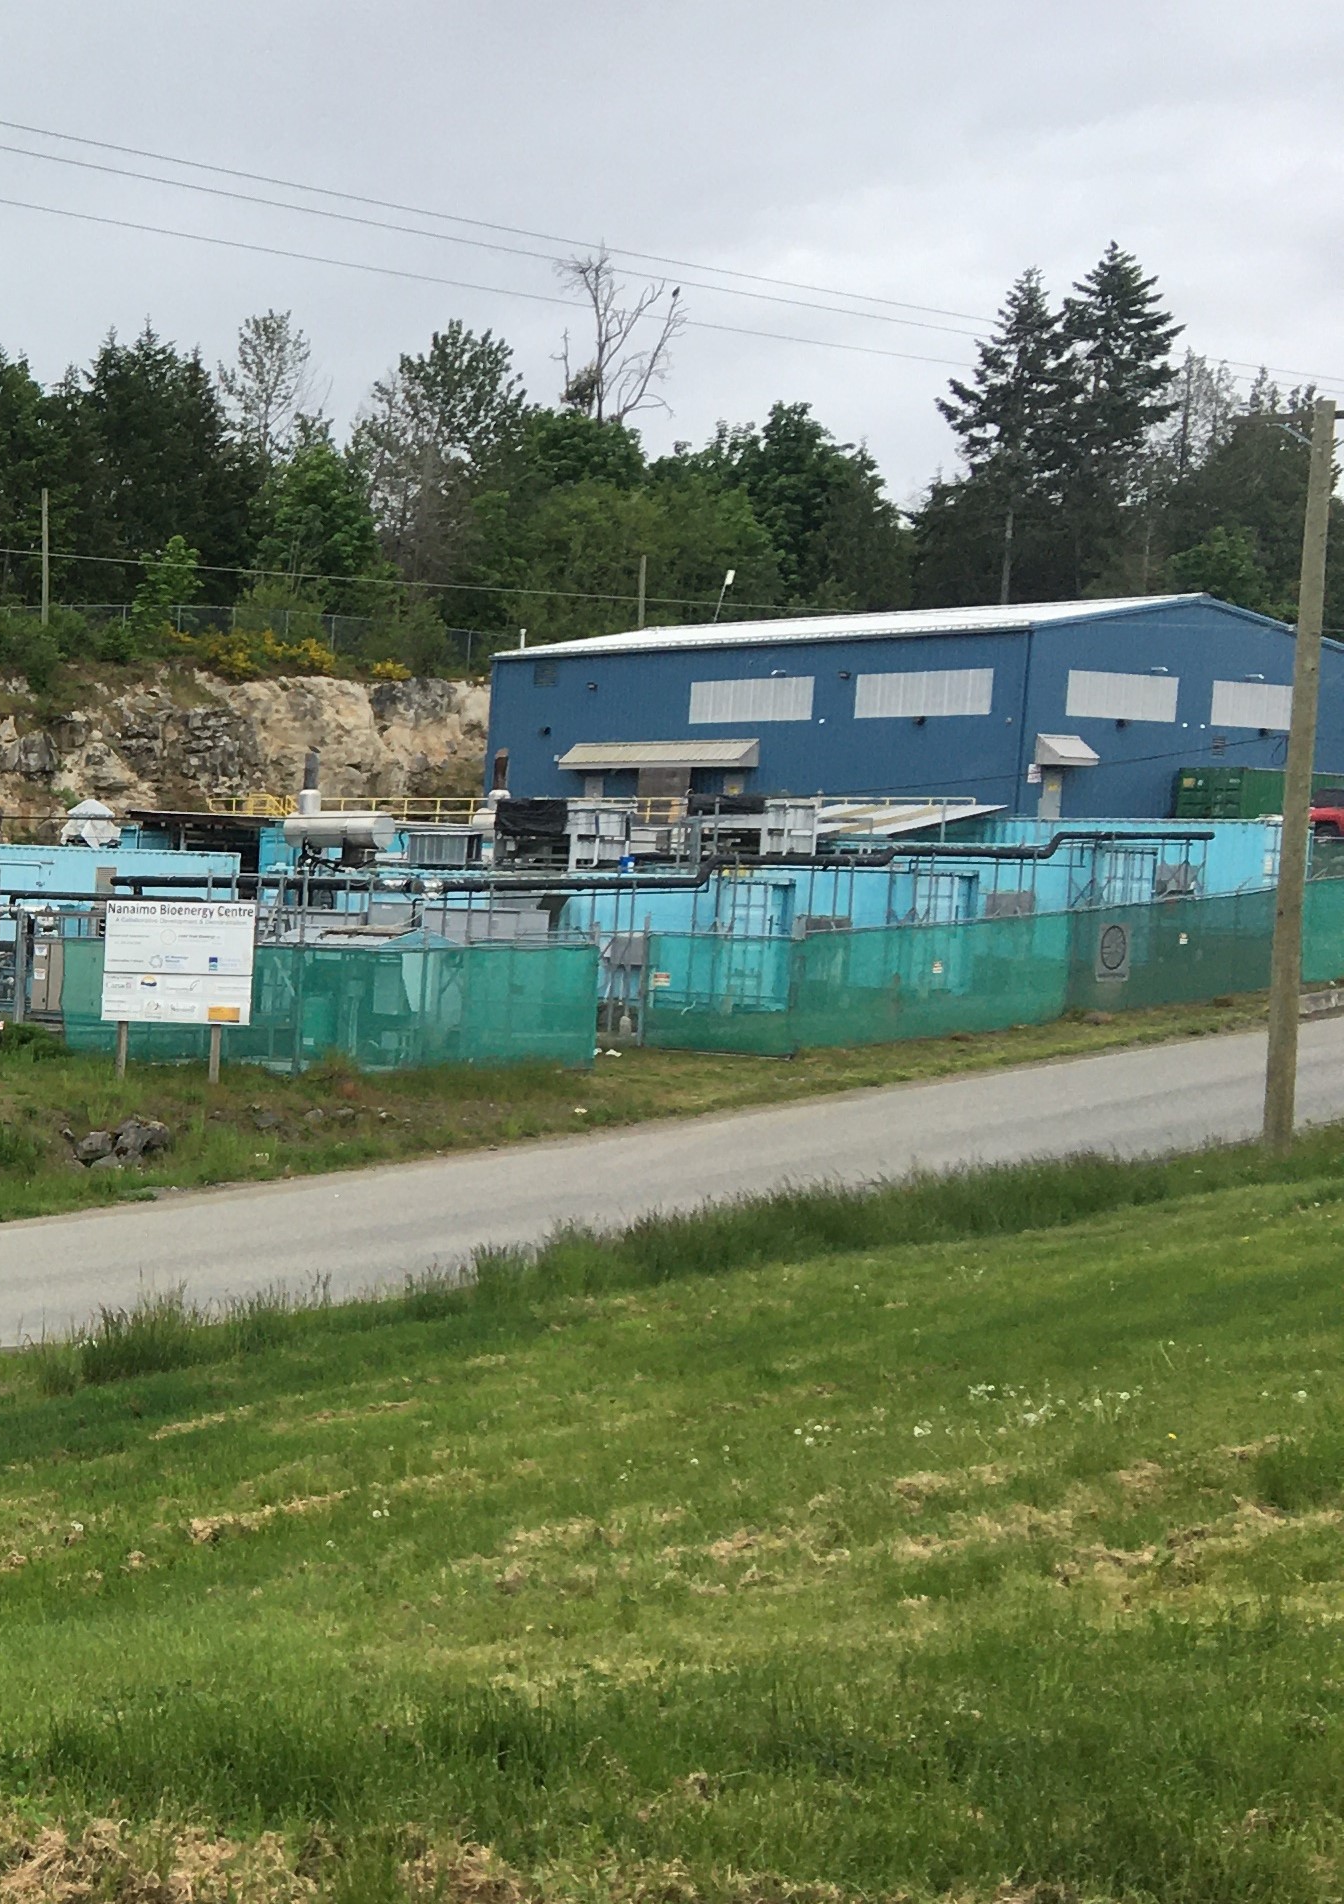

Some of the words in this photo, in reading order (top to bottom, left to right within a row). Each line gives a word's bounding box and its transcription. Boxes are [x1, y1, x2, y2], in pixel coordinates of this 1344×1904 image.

[108, 903, 157, 915] Nanaimo
[160, 904, 215, 919] Bioenergy
[217, 905, 254, 918] Centre
